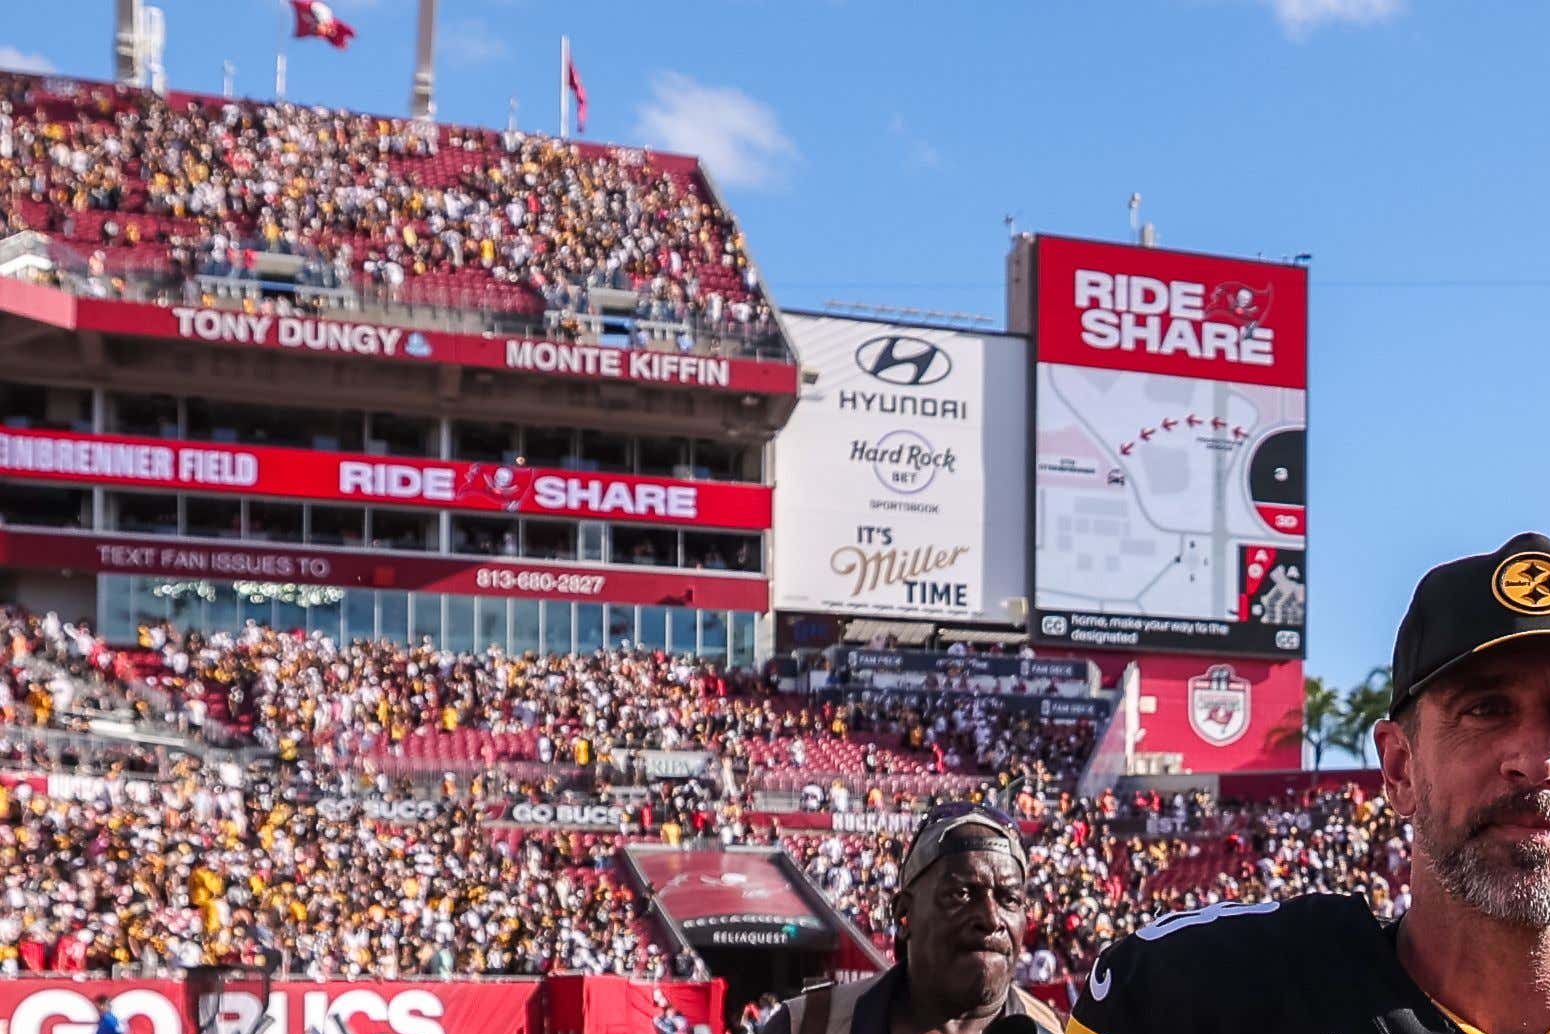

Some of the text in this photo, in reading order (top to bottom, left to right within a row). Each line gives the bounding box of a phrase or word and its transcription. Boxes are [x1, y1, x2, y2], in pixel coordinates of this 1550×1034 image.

[1074, 268, 1206, 322] RIDE
[173, 307, 402, 356] TONY DUNGY
[1081, 309, 1275, 367] SHARE
[506, 339, 730, 387] MONTE KIFFIN
[839, 389, 967, 420] HYUNDAI
[178, 447, 259, 487] FIELD
[849, 440, 956, 473] Hard Rock
[339, 461, 698, 518] RIDE SHARE
[856, 525, 894, 546] IT'S
[98, 543, 331, 578] TEXT FAN ISSUES TO
[830, 544, 970, 597] Miller
[903, 580, 968, 607] TIME
[1070, 629, 1140, 645] designated
[1071, 613, 1107, 628] home,
[1109, 615, 1143, 630] make
[1194, 622, 1207, 635] to
[512, 802, 622, 826] GO BUCS
[713, 931, 788, 944] RELIAQUEST
